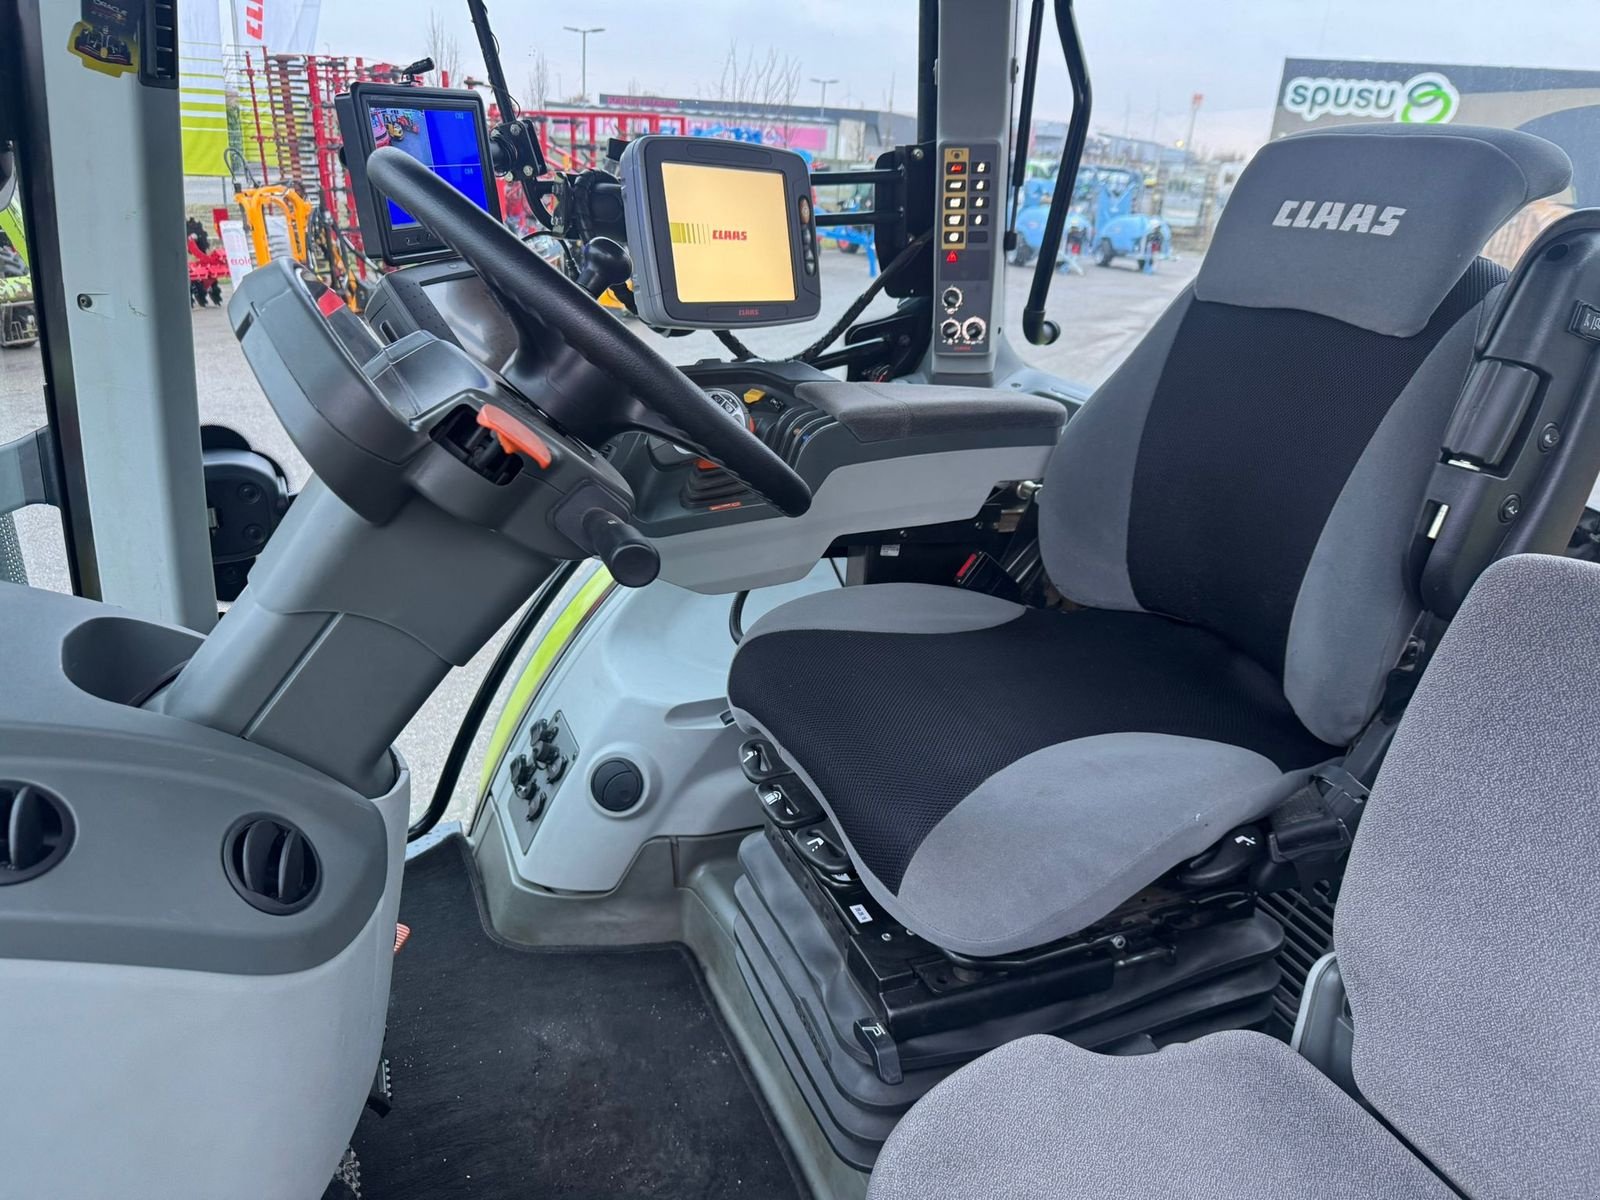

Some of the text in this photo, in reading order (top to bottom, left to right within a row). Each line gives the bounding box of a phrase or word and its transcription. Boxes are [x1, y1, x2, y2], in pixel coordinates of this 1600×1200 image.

[1290, 83, 1396, 113] spusu
[1271, 199, 1408, 236] CLAAS
[712, 229, 748, 241] CLAAS
